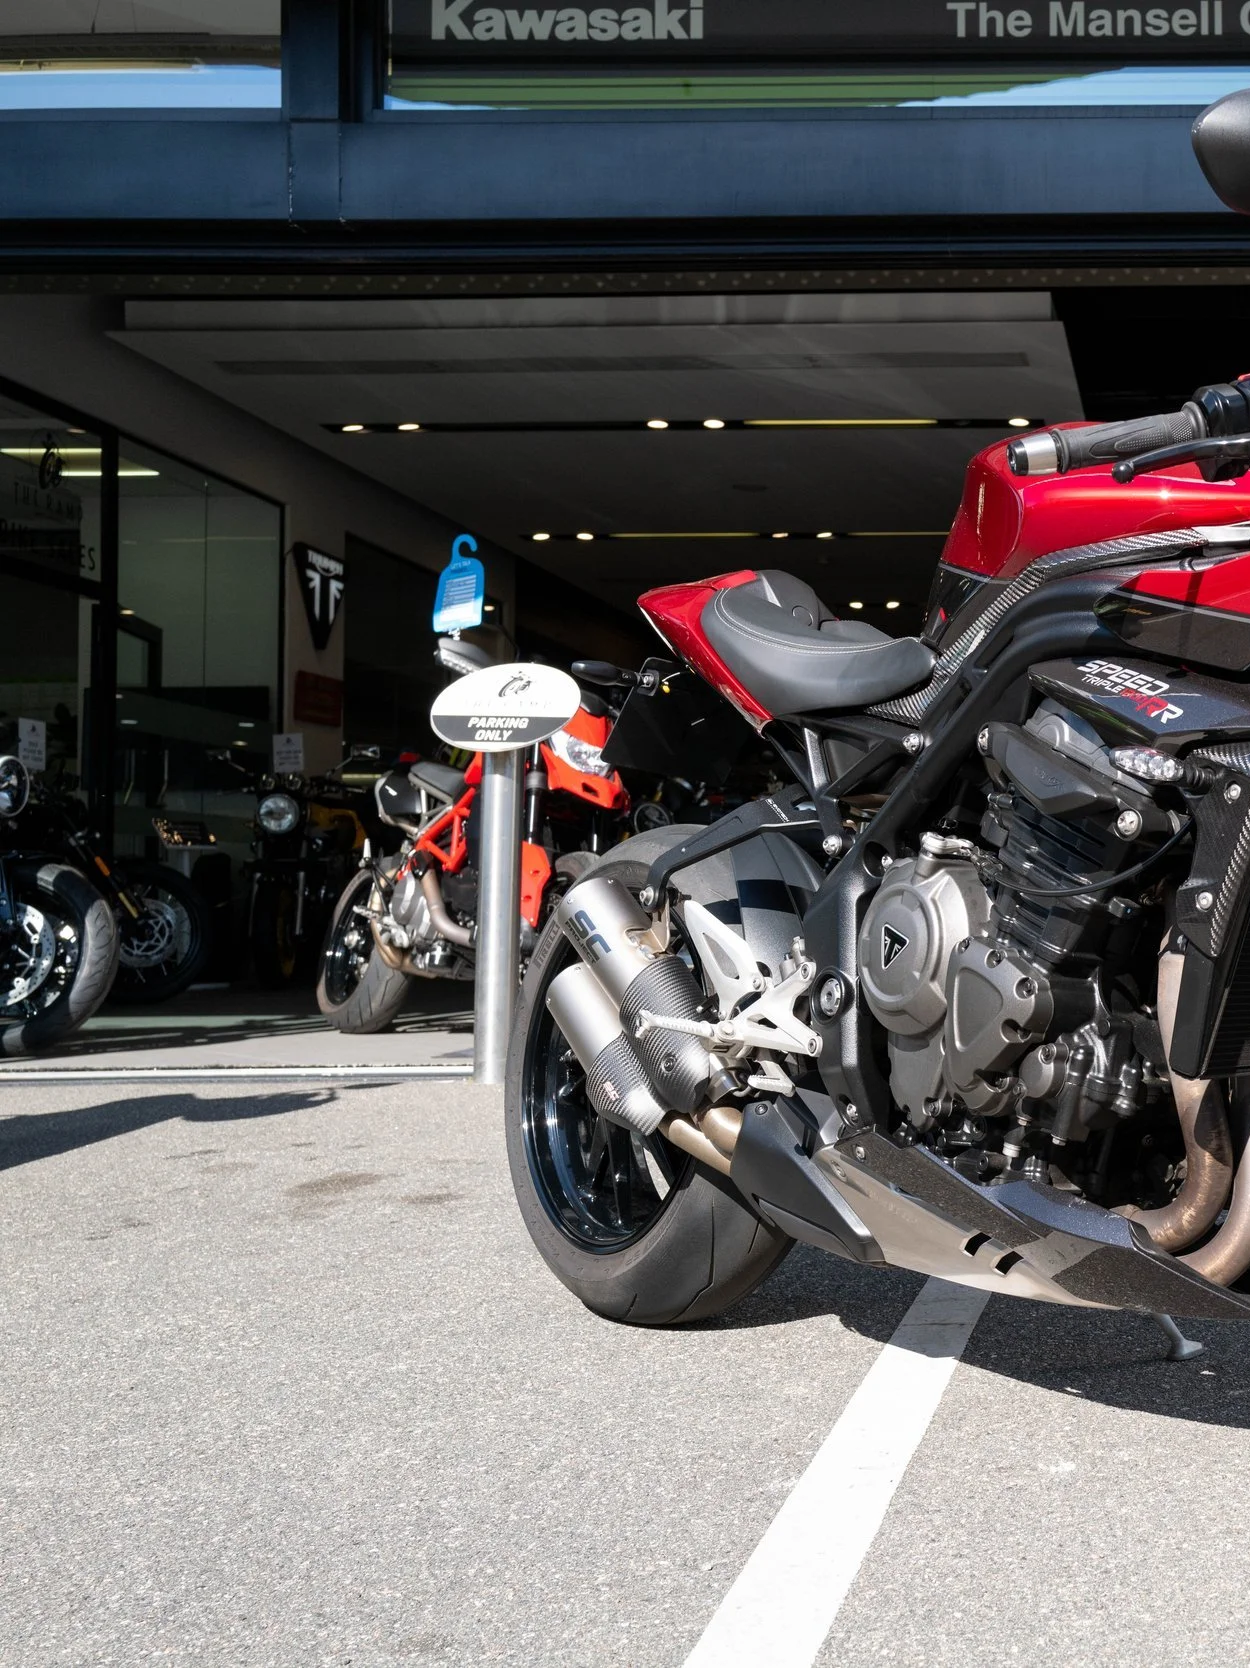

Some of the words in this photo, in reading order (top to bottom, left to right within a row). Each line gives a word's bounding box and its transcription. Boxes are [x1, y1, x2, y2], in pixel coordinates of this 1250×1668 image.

[431, 0, 704, 41] Kawasaki
[946, 2, 1032, 38] The
[1049, 0, 1223, 37] Mansell
[1076, 660, 1170, 696] SPEED
[1081, 674, 1127, 693] TRIPLE
[467, 717, 530, 729] PARKING
[474, 730, 513, 741] ONLY
[564, 921, 598, 964] PROJECT
[565, 910, 612, 962] SC
